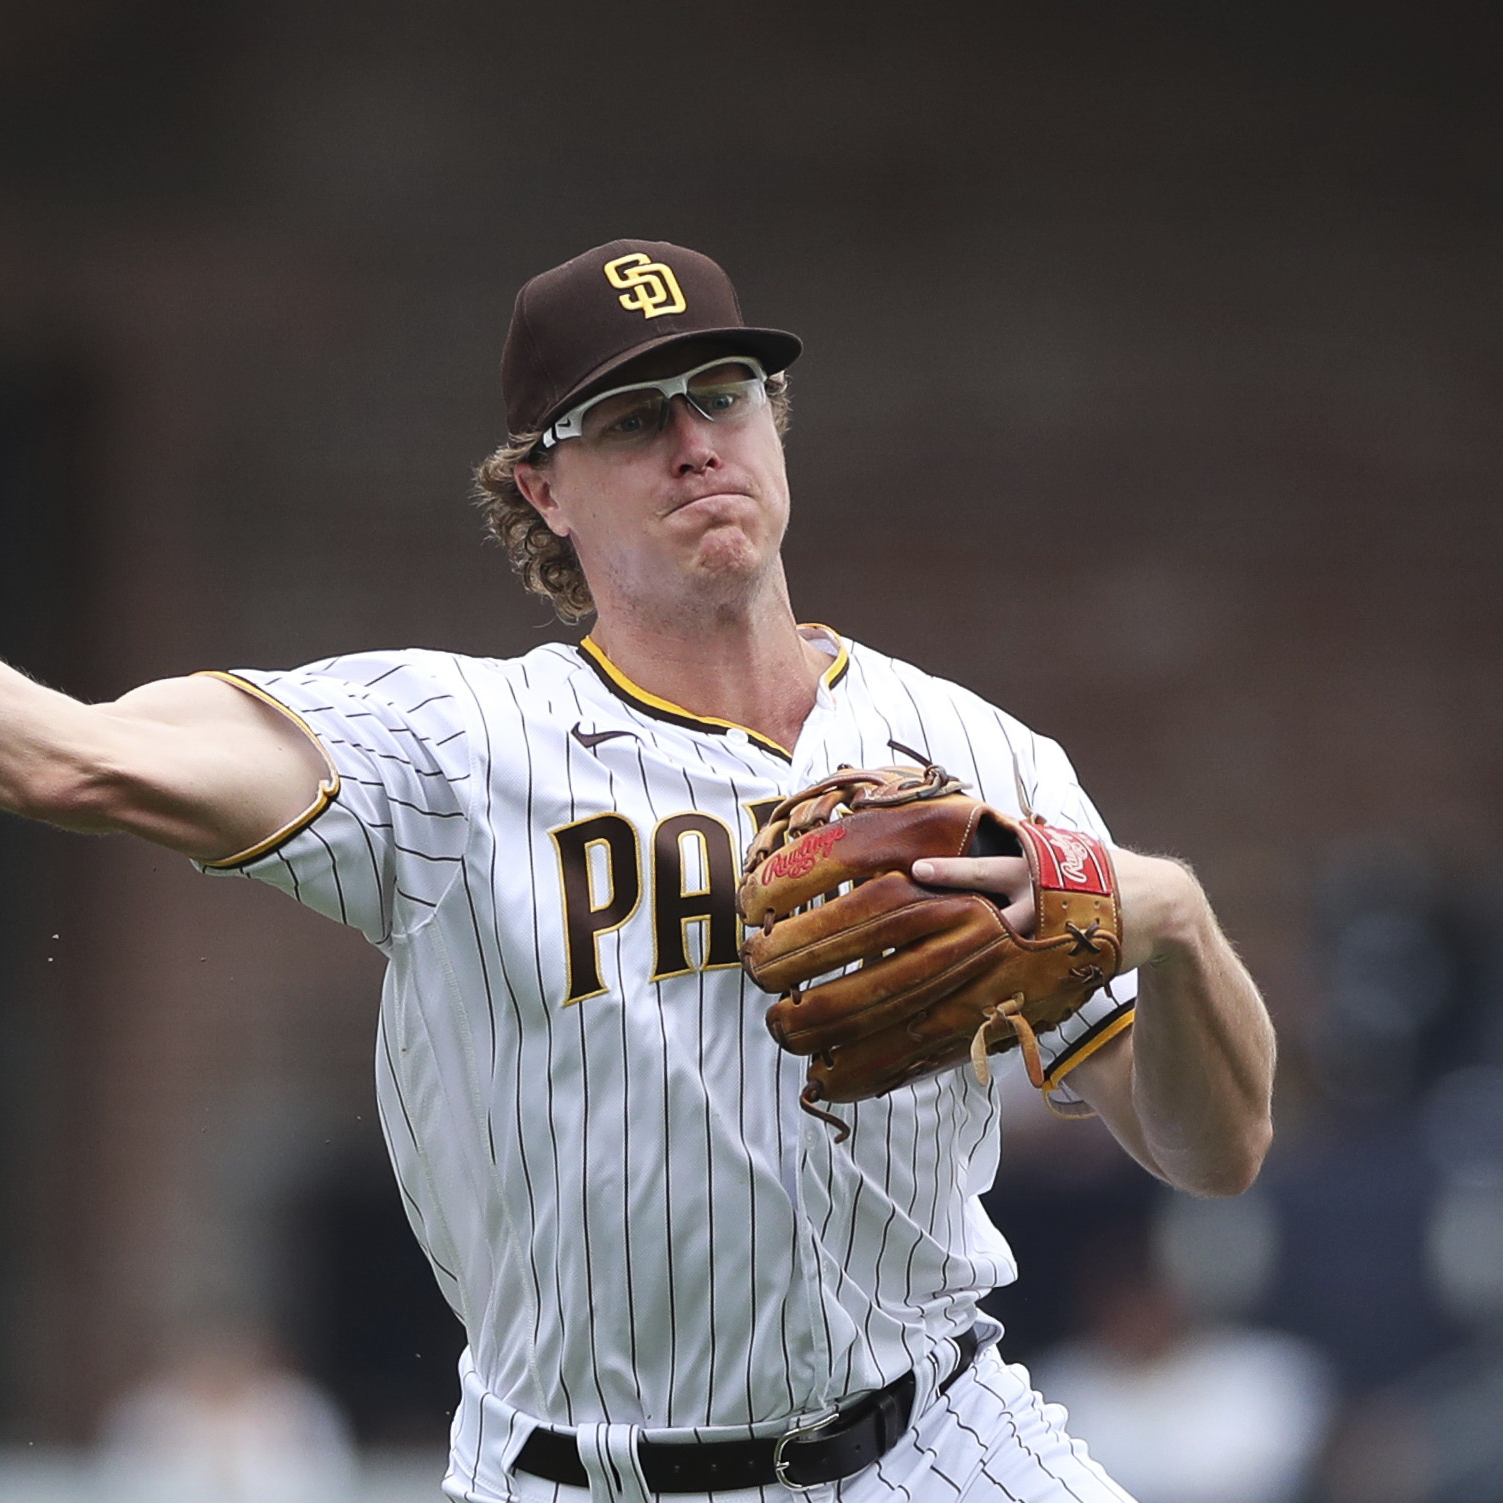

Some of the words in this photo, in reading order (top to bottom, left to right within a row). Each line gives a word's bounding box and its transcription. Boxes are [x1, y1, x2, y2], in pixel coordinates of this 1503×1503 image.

[604, 252, 687, 320] SD
[762, 825, 847, 886] Rawlings
[548, 797, 788, 1007] PA
